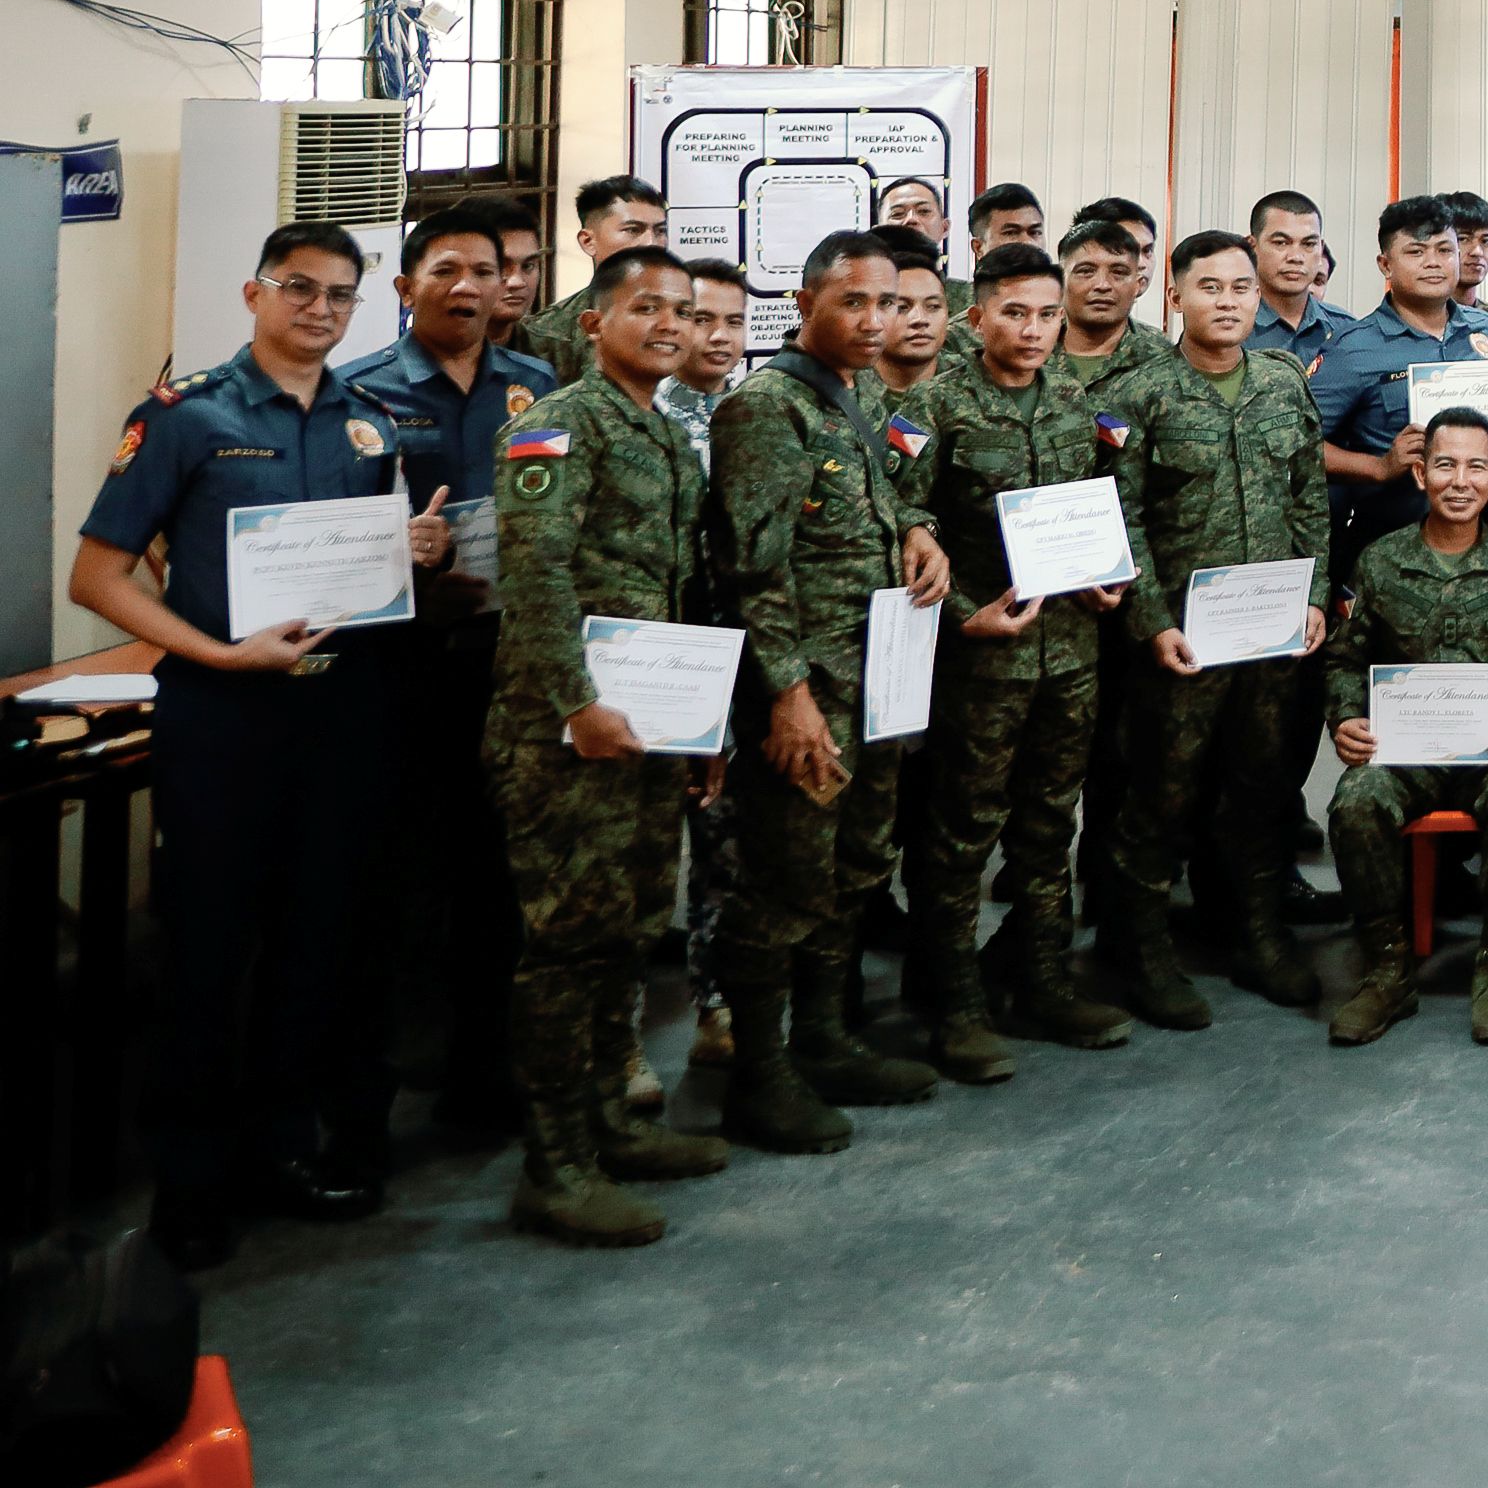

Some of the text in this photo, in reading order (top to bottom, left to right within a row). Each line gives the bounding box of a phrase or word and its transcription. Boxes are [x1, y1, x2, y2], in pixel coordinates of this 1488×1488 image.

[685, 133, 746, 141] PREPARING
[782, 135, 830, 143] MEETING
[676, 144, 756, 152] FOR PLANNING
[680, 226, 726, 234] TACTICS
[680, 237, 729, 245] MEETING
[1420, 387, 1459, 400] Certificate
[1012, 518, 1051, 530] Certificate
[1060, 507, 1112, 522] Attendance
[244, 529, 397, 556] Certificate of Attendance
[1198, 591, 1236, 604] Certificate
[1247, 583, 1301, 597] Attendance
[592, 648, 645, 669] Certificate
[658, 652, 727, 673] Attendance
[1380, 687, 1423, 705] Certificate
